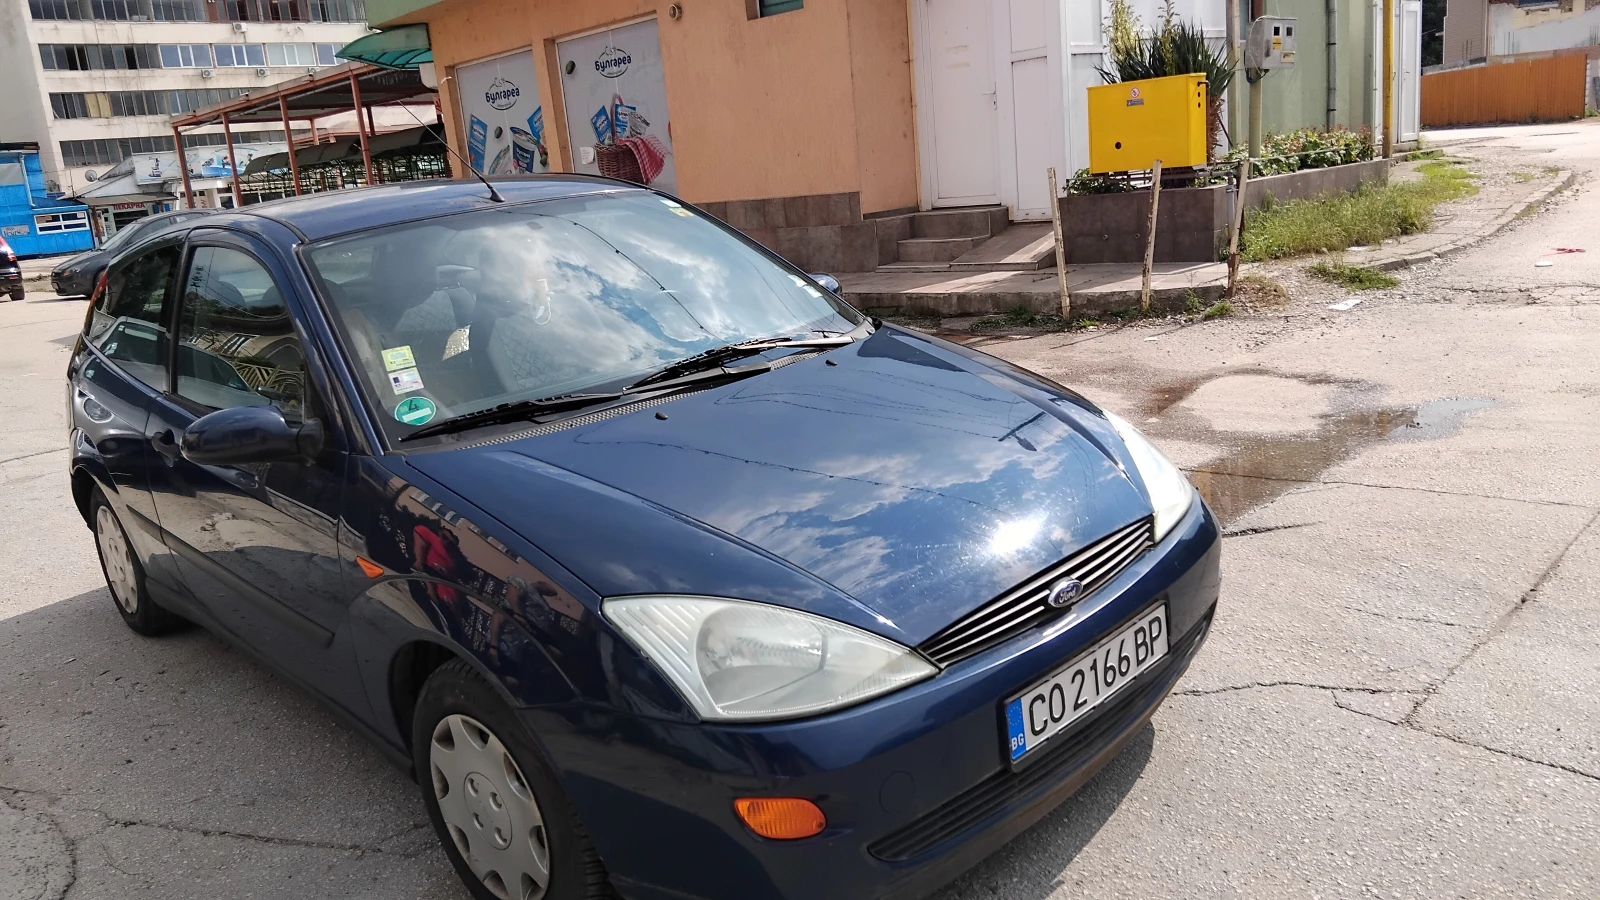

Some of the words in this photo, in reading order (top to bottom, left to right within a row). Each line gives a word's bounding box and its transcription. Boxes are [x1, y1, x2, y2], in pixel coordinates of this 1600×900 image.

[408, 400, 419, 411] 4
[1059, 587, 1077, 603] Ford
[1071, 638, 1131, 712] 2166
[1011, 732, 1025, 751] BG
